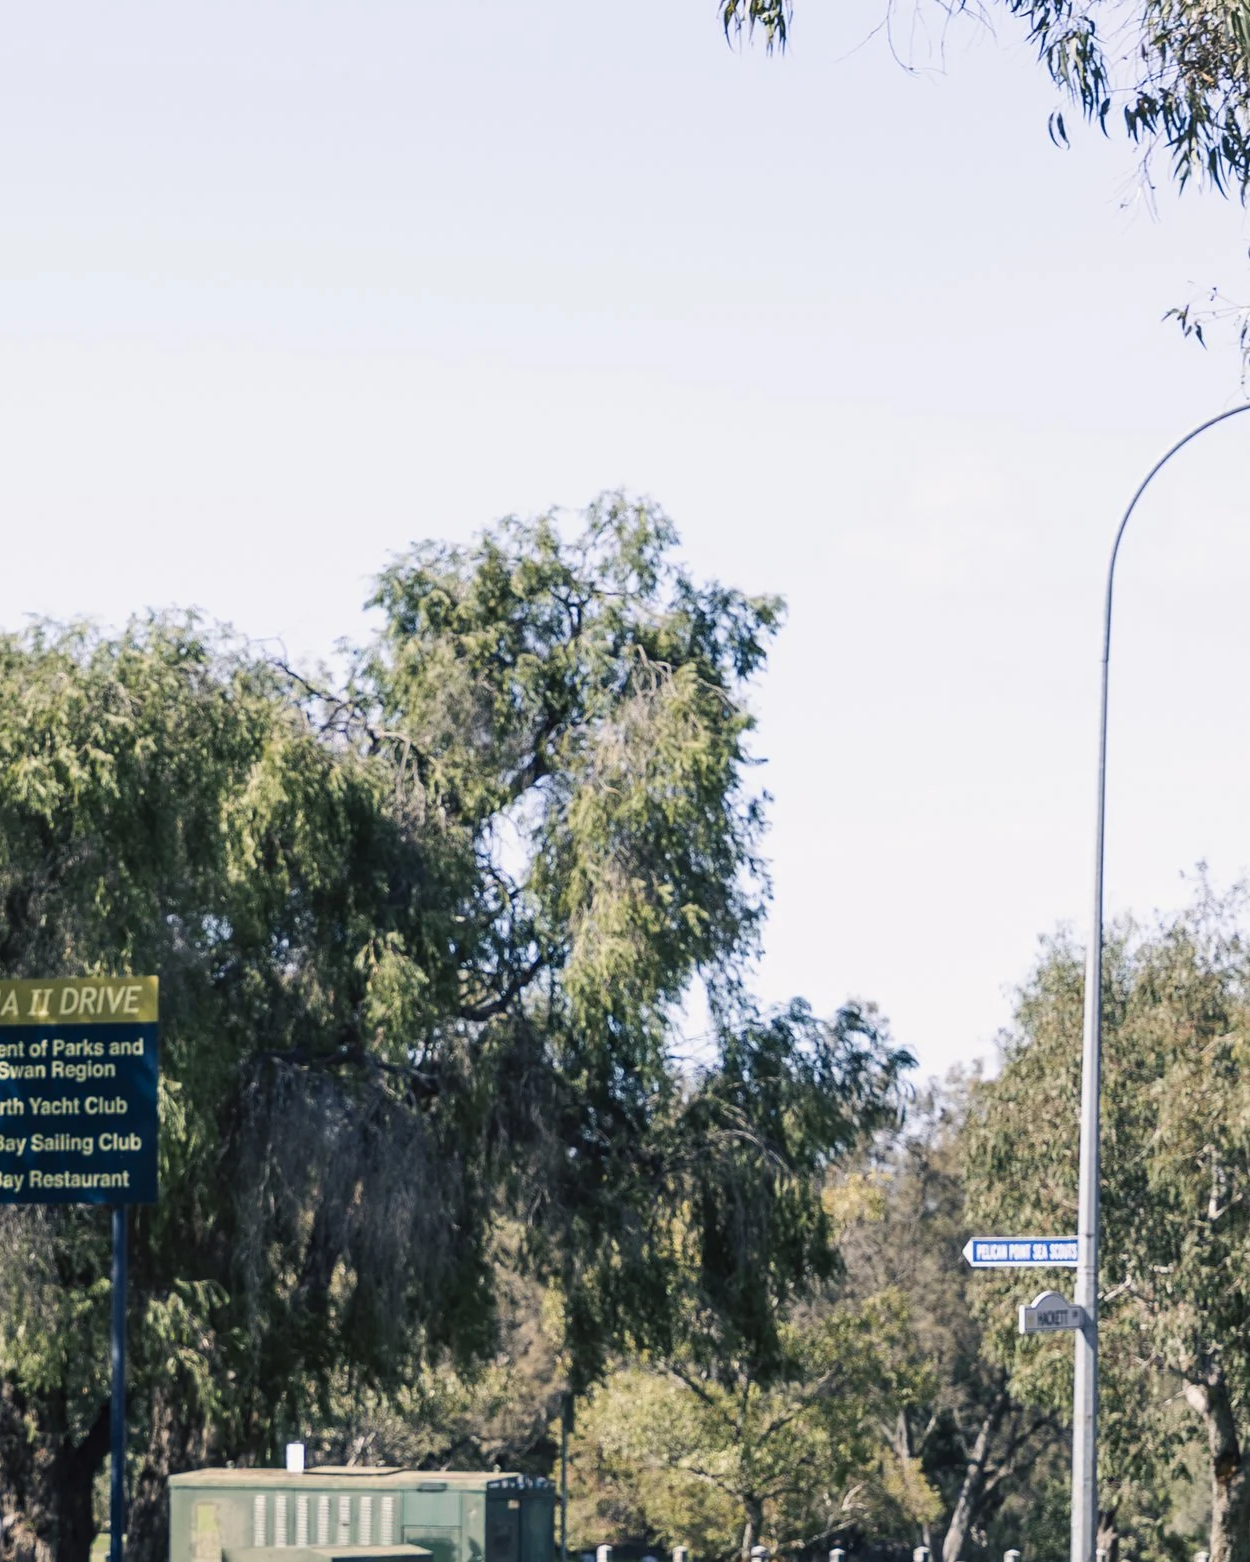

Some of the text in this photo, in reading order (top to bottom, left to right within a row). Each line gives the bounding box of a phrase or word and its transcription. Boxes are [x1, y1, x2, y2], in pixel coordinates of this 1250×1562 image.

[27, 988, 54, 1017] II
[59, 986, 143, 1016] DRIVE
[29, 1039, 48, 1057] of
[52, 1038, 105, 1057] Parks
[108, 1037, 144, 1056] and
[51, 1060, 116, 1083] Region
[29, 1097, 80, 1115] Yacht
[85, 1096, 128, 1115] Club
[31, 1133, 94, 1156] Sailing
[98, 1132, 142, 1151] Club
[29, 1169, 130, 1189] Restaurant
[976, 1243, 1008, 1261] PELICAN
[1032, 1243, 1048, 1260] SEA
